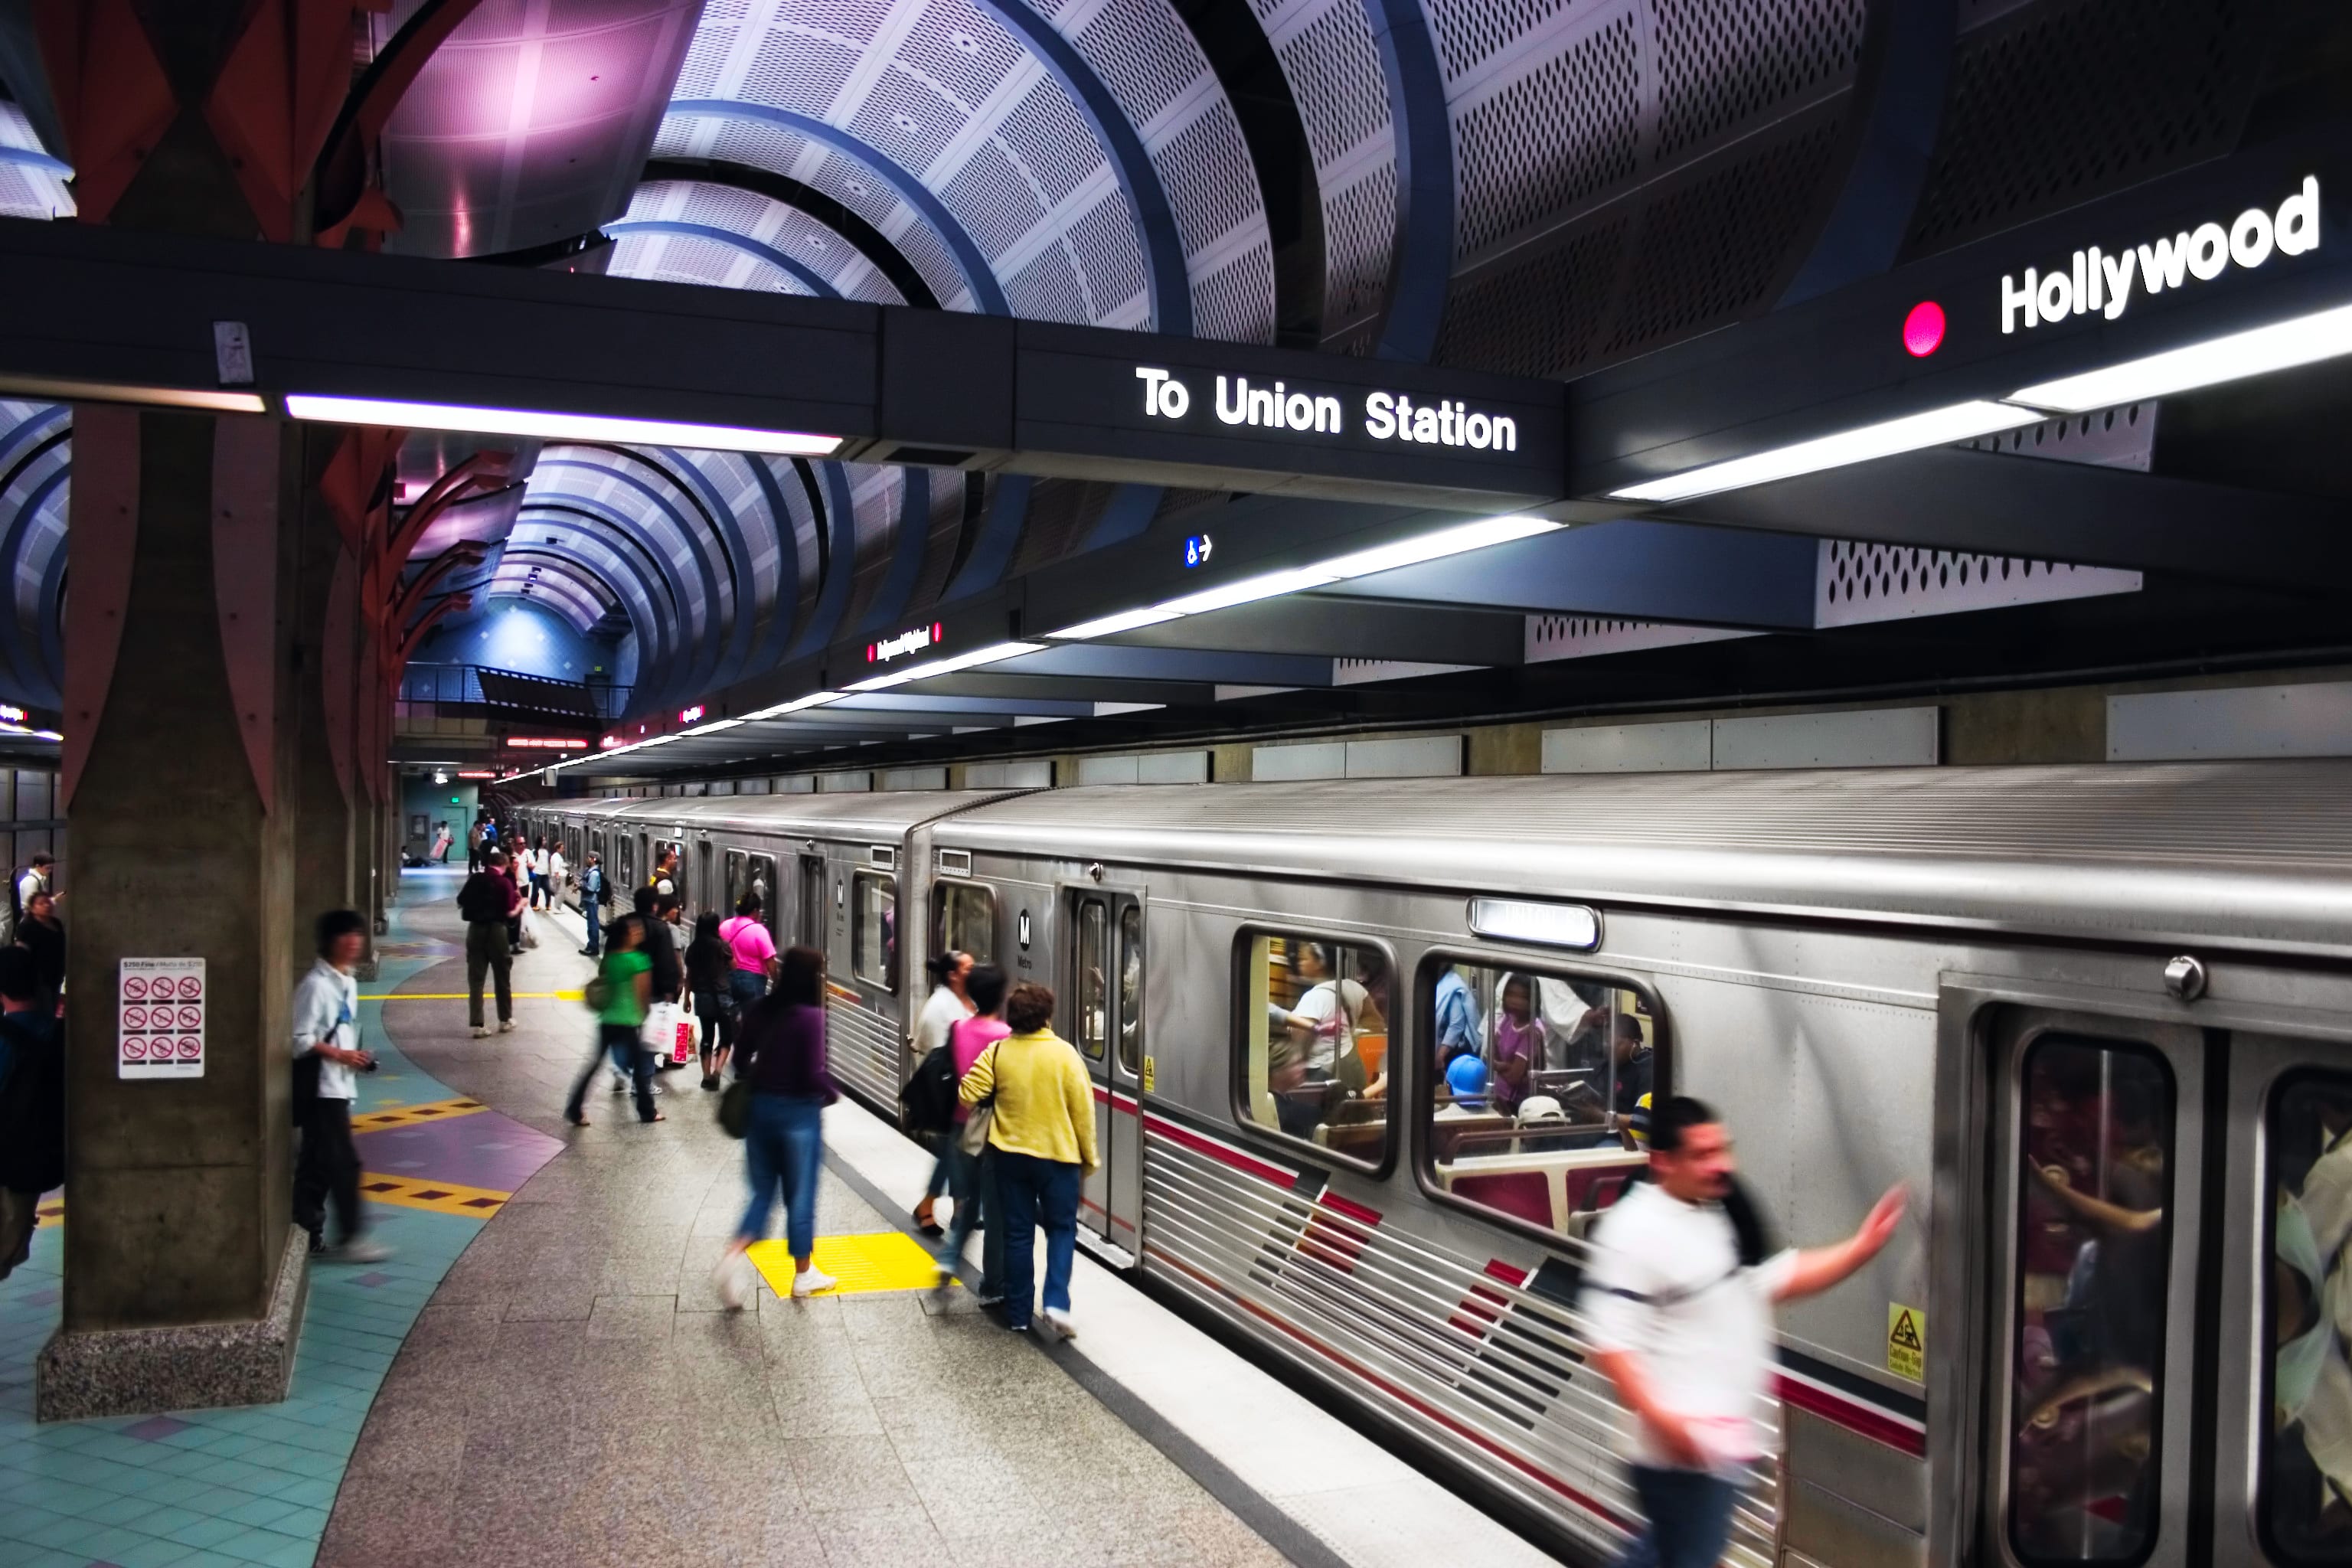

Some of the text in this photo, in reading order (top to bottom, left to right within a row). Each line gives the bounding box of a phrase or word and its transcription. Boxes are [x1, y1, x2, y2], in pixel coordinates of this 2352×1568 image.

[2001, 175, 2320, 335] Hollywood
[1136, 367, 1517, 452] To Union Station
[1020, 916, 1030, 945] M
[1018, 955, 1032, 970] Metro
